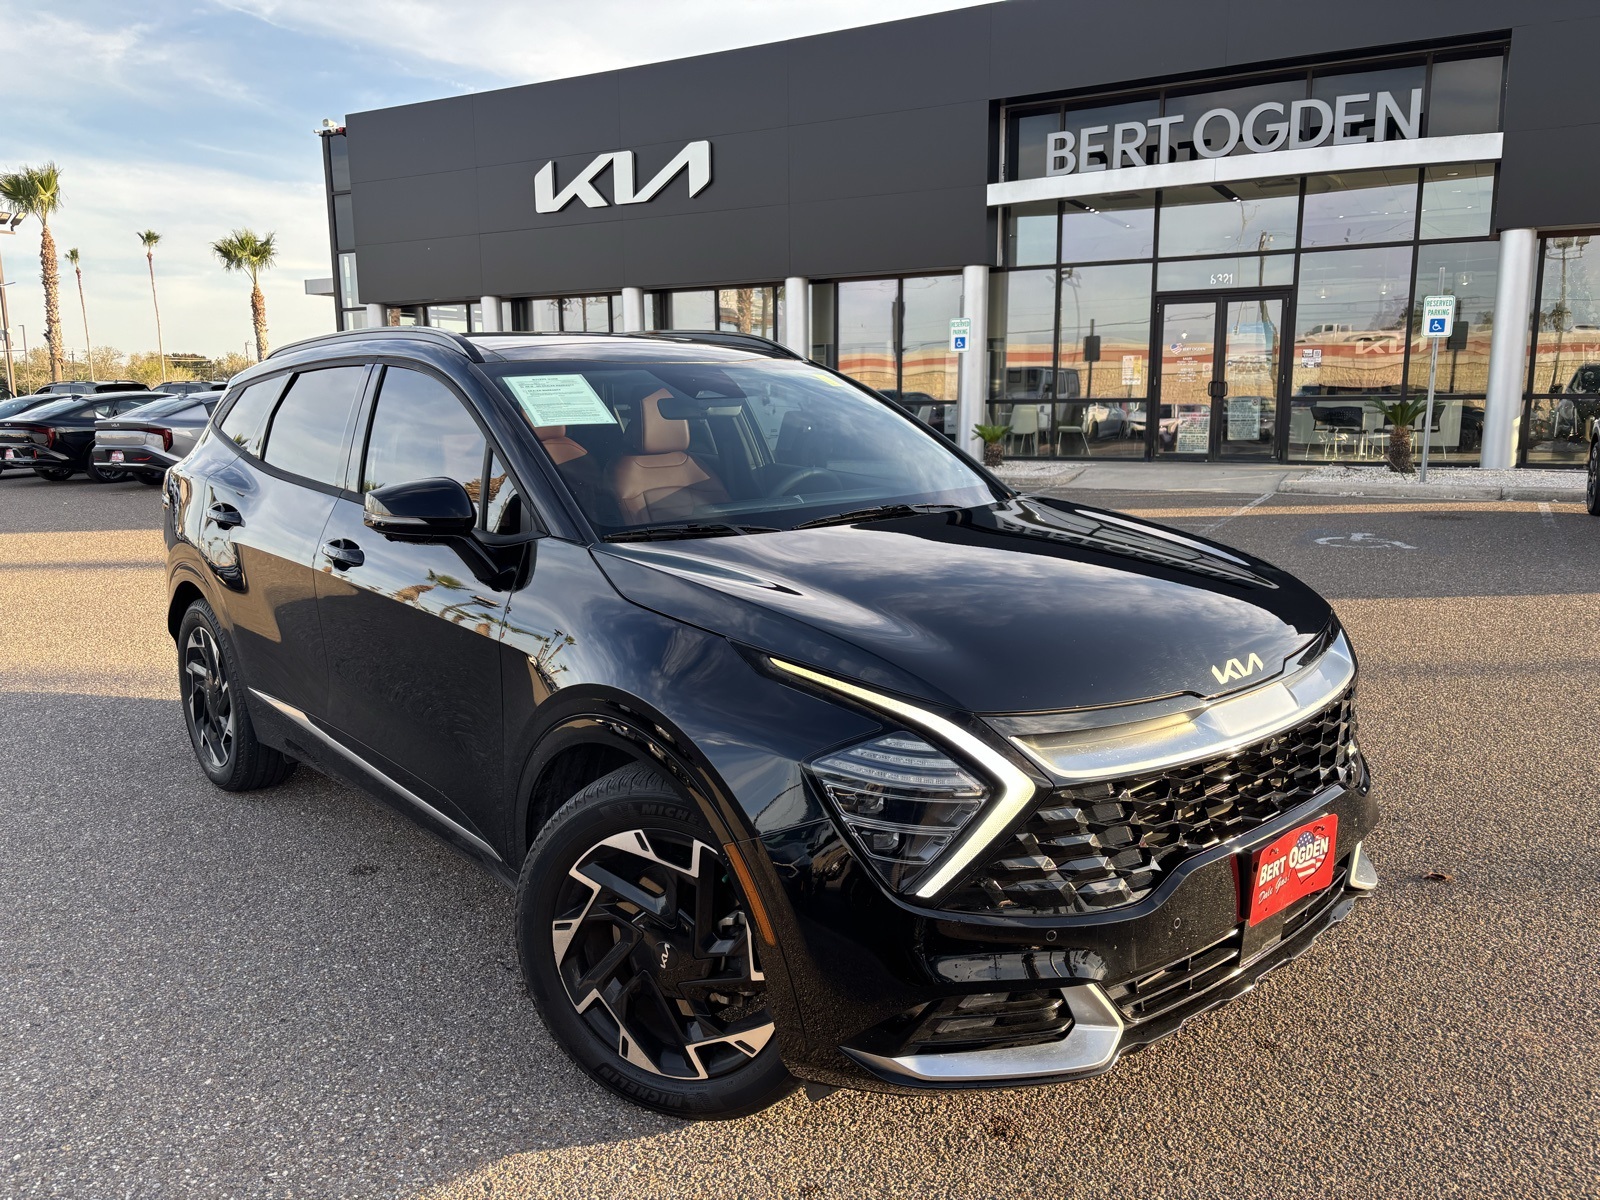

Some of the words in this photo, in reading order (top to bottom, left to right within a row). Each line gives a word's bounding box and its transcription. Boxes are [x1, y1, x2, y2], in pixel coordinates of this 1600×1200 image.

[1046, 114, 1184, 177] BERT
[1193, 88, 1422, 158] OGDEN
[534, 139, 712, 214] KIA
[1210, 273, 1233, 285] 6321
[1426, 299, 1453, 307] RESERVED
[1427, 308, 1450, 316] PARKING
[1211, 652, 1264, 685] KIA
[640, 803, 699, 824] MICHE
[1258, 856, 1287, 887] BERT
[1288, 837, 1329, 869] OGDEN
[598, 1066, 683, 1108] MICHELIN
